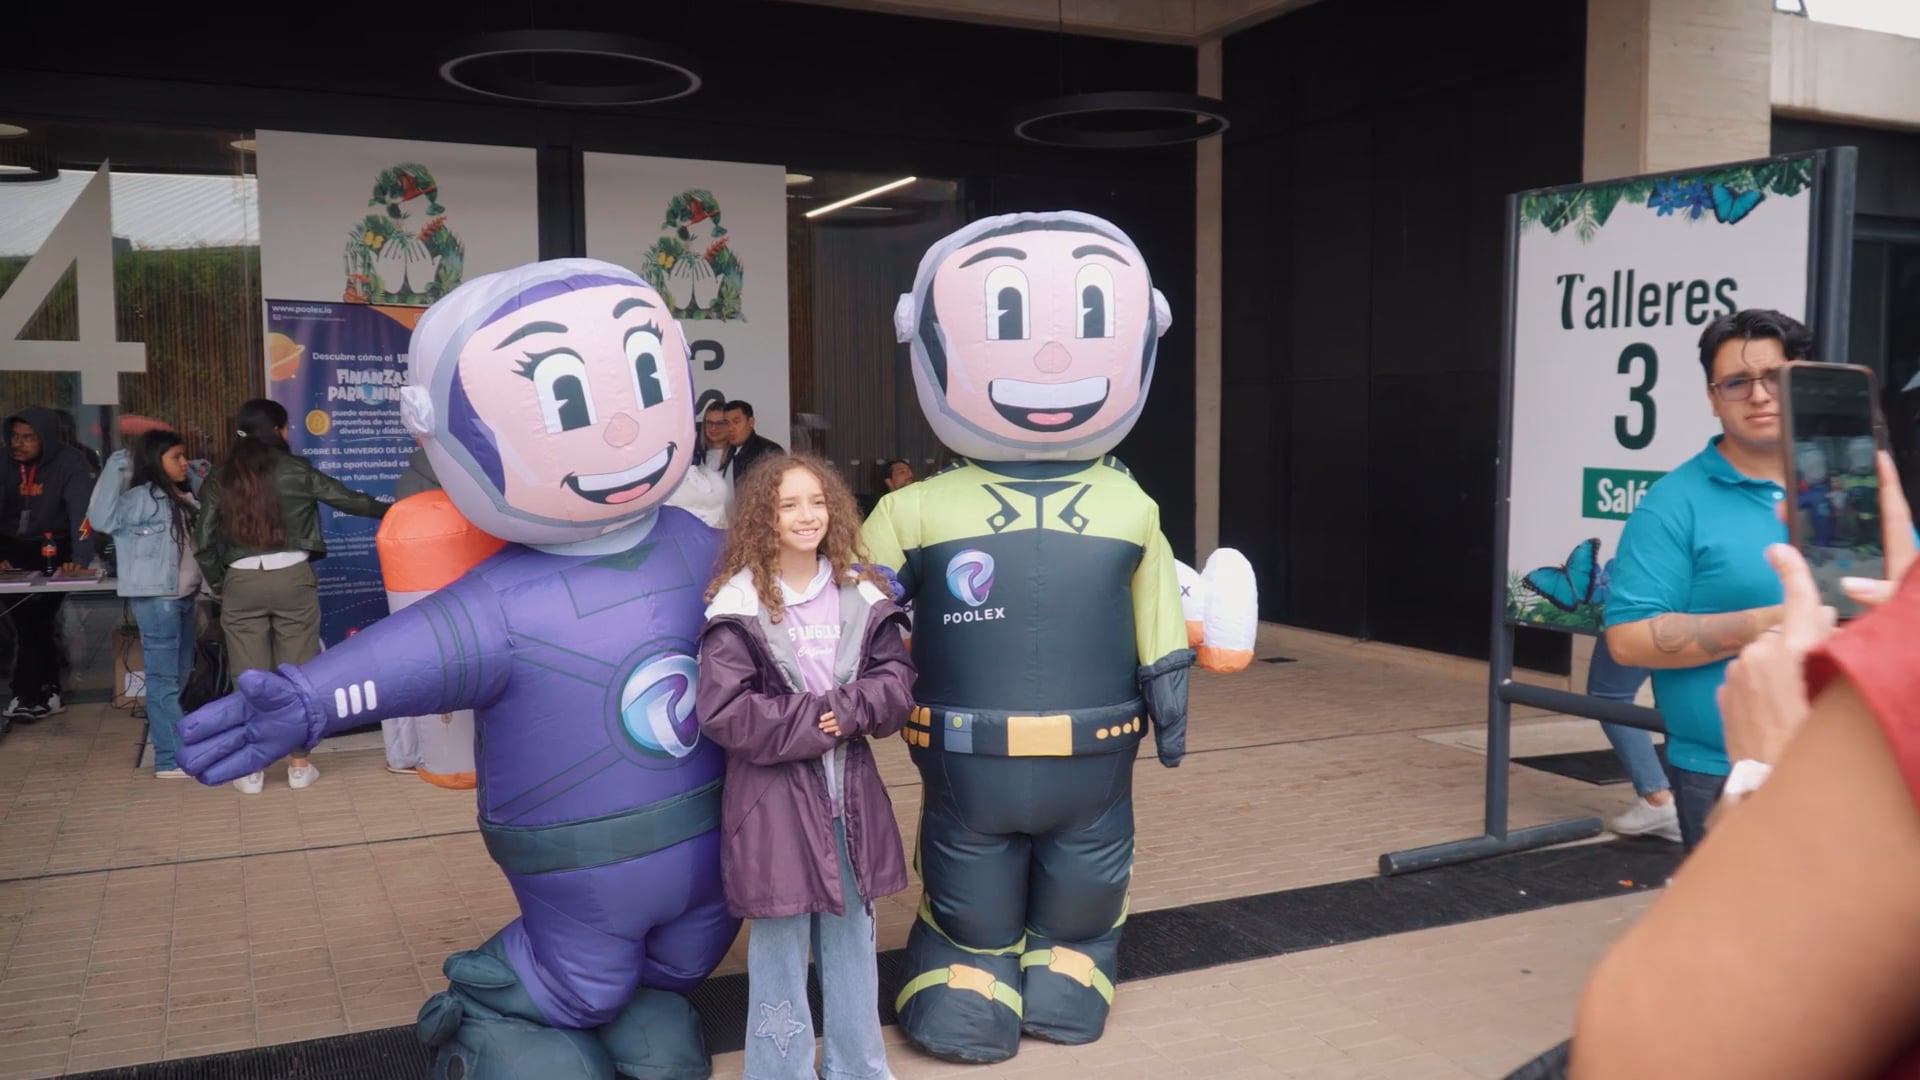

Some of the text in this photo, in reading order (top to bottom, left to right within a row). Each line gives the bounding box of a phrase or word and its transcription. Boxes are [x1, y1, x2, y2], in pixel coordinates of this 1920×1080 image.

[1557, 269, 1738, 330] Talleres
[312, 352, 356, 361] Descubre
[357, 353, 383, 362] cómo
[384, 354, 393, 362] el
[327, 385, 365, 402] PARA
[1614, 342, 1659, 450] 3
[332, 409, 357, 418] puede
[332, 418, 372, 427] pequeños
[373, 418, 382, 426] de
[339, 427, 375, 435] divertida
[302, 447, 330, 456] SOBRE
[331, 447, 342, 455] EL
[343, 446, 384, 455] UNIVERSO
[385, 446, 397, 454] DE
[398, 446, 414, 454] LAS
[343, 459, 397, 470] oportunidad
[353, 473, 378, 481] futuro
[943, 607, 1006, 625] POOLEX
